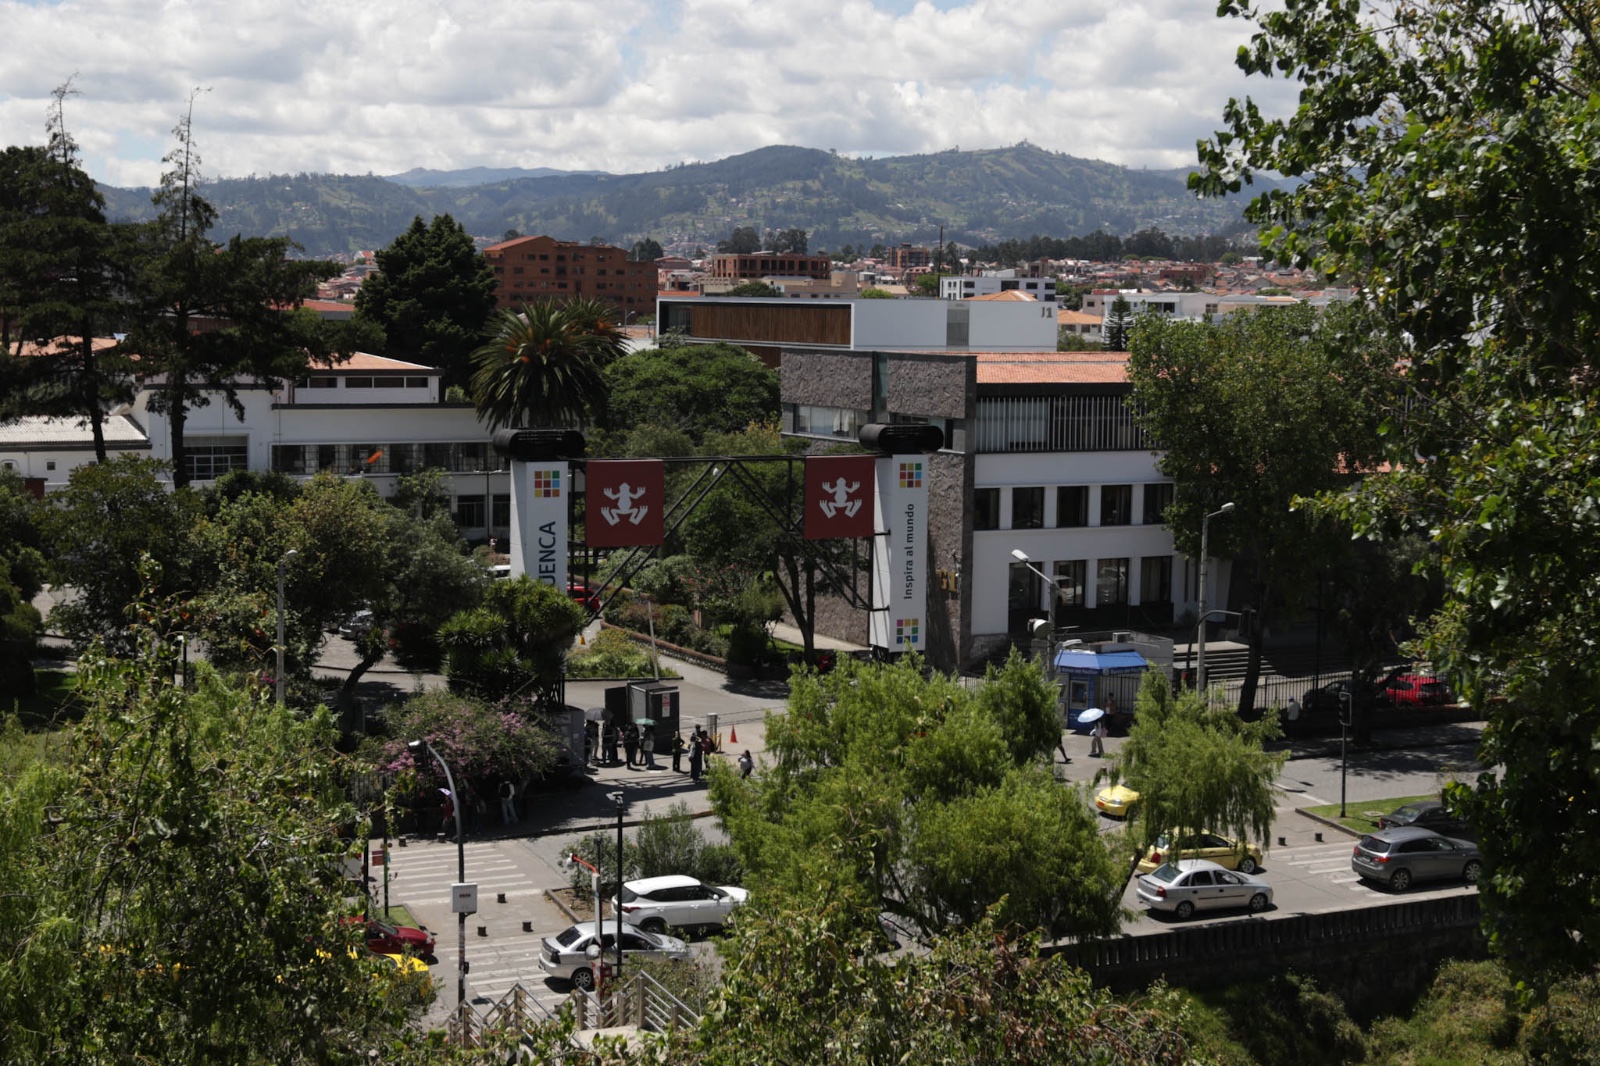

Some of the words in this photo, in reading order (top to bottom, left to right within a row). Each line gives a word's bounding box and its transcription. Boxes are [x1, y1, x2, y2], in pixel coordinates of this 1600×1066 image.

[1040, 306, 1053, 318] J1
[904, 503, 915, 543] mundo
[904, 546, 914, 557] al
[904, 560, 915, 600] Inspira
